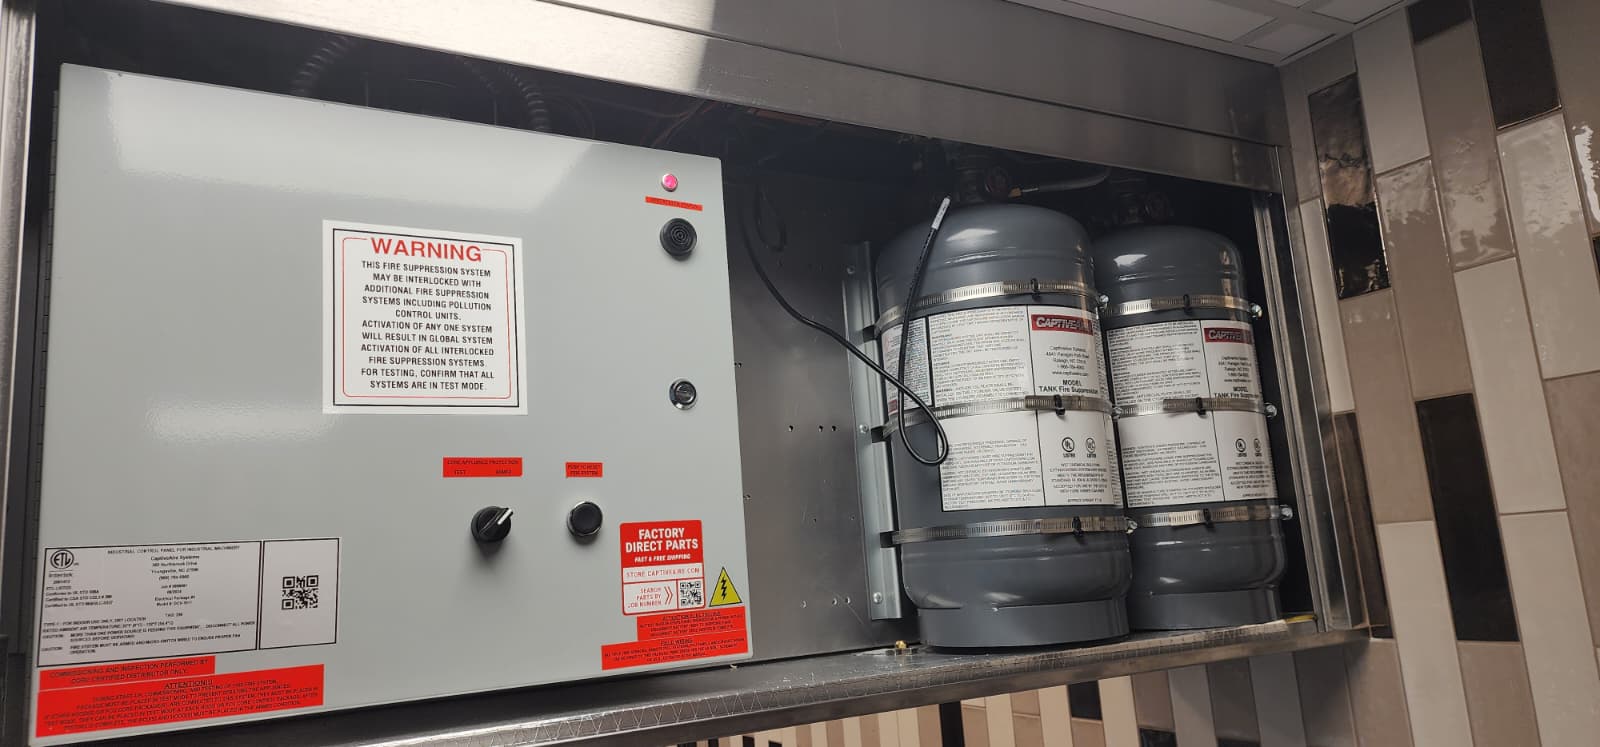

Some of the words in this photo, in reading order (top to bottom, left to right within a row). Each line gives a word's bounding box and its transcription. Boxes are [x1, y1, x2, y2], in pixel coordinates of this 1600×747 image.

[371, 237, 481, 262] WARNING
[362, 261, 380, 269] THIS
[383, 262, 400, 270] FIRE
[403, 264, 458, 275] SUPPRESSION
[461, 268, 490, 277] SYSTEM
[406, 276, 459, 286] INTERLOCKED
[462, 279, 480, 287] WITH
[364, 285, 412, 294] ADDITIONAL
[416, 288, 433, 296] FIRE
[435, 289, 489, 299] SUPPRESSION
[362, 296, 400, 305] SYSTEMS
[404, 299, 446, 308] INCLUDING
[449, 301, 491, 311] POLLUTION
[395, 310, 433, 319] CONTROL
[435, 312, 461, 320] UNITS.
[362, 320, 410, 329] ACTIVATION
[426, 323, 441, 331] ANY
[462, 325, 492, 333] SYSTEM
[385, 334, 416, 342] RESULT
[429, 335, 459, 343] GLOBAL
[462, 336, 492, 344] SYSTEM
[361, 344, 409, 353] ACTIVATION
[441, 347, 494, 356] INTERLOCKED
[389, 357, 446, 366] SUPPRESSION
[361, 368, 378, 376] FOR
[381, 369, 417, 378] TESTING,
[420, 370, 457, 378] CONFIRM
[460, 370, 478, 378] THAT
[481, 371, 494, 379] ALL
[370, 381, 408, 389] SYSTEMS
[440, 382, 459, 390] TEST
[639, 528, 684, 540] FACTORY
[626, 540, 664, 553] DIRECT
[666, 539, 698, 550] PARTS
